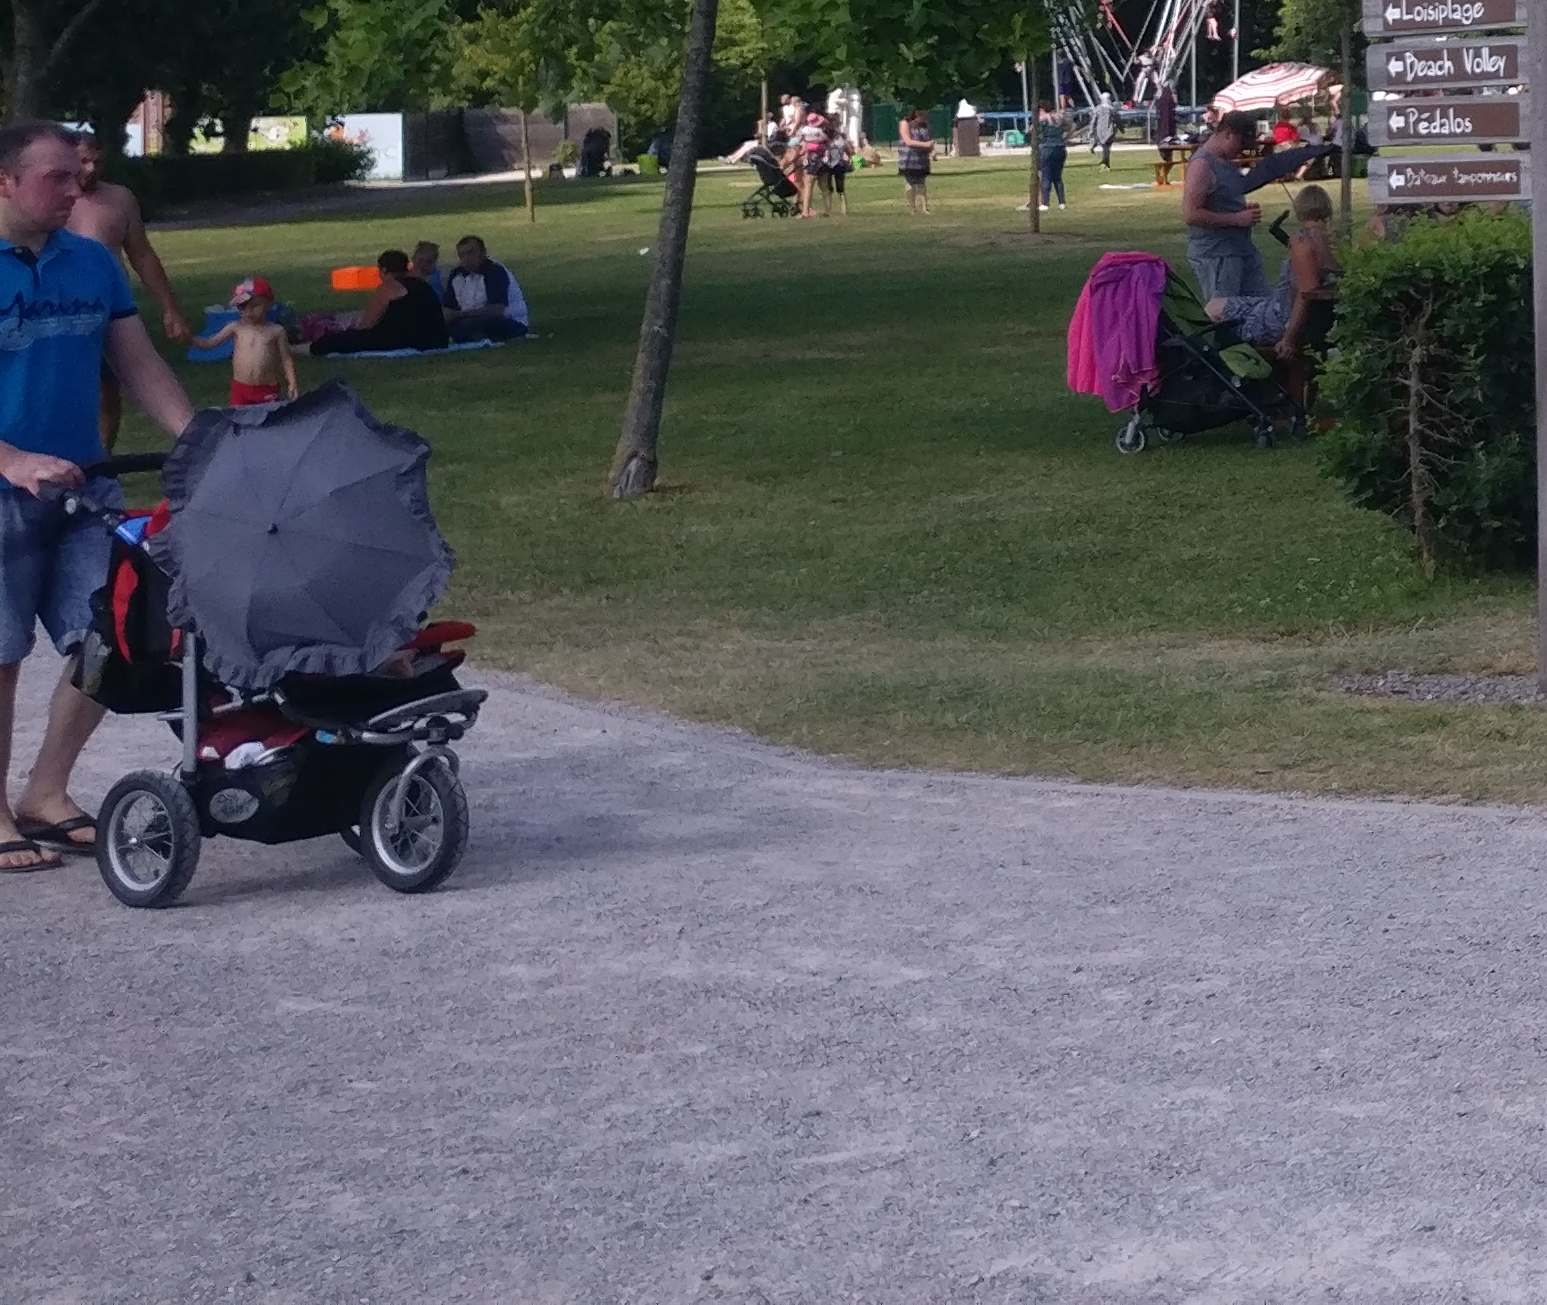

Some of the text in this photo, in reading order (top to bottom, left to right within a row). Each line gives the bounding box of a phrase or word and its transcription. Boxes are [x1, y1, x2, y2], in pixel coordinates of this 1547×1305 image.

[1404, 47, 1507, 83] Beach Volley
[1406, 107, 1473, 135] Pédalos
